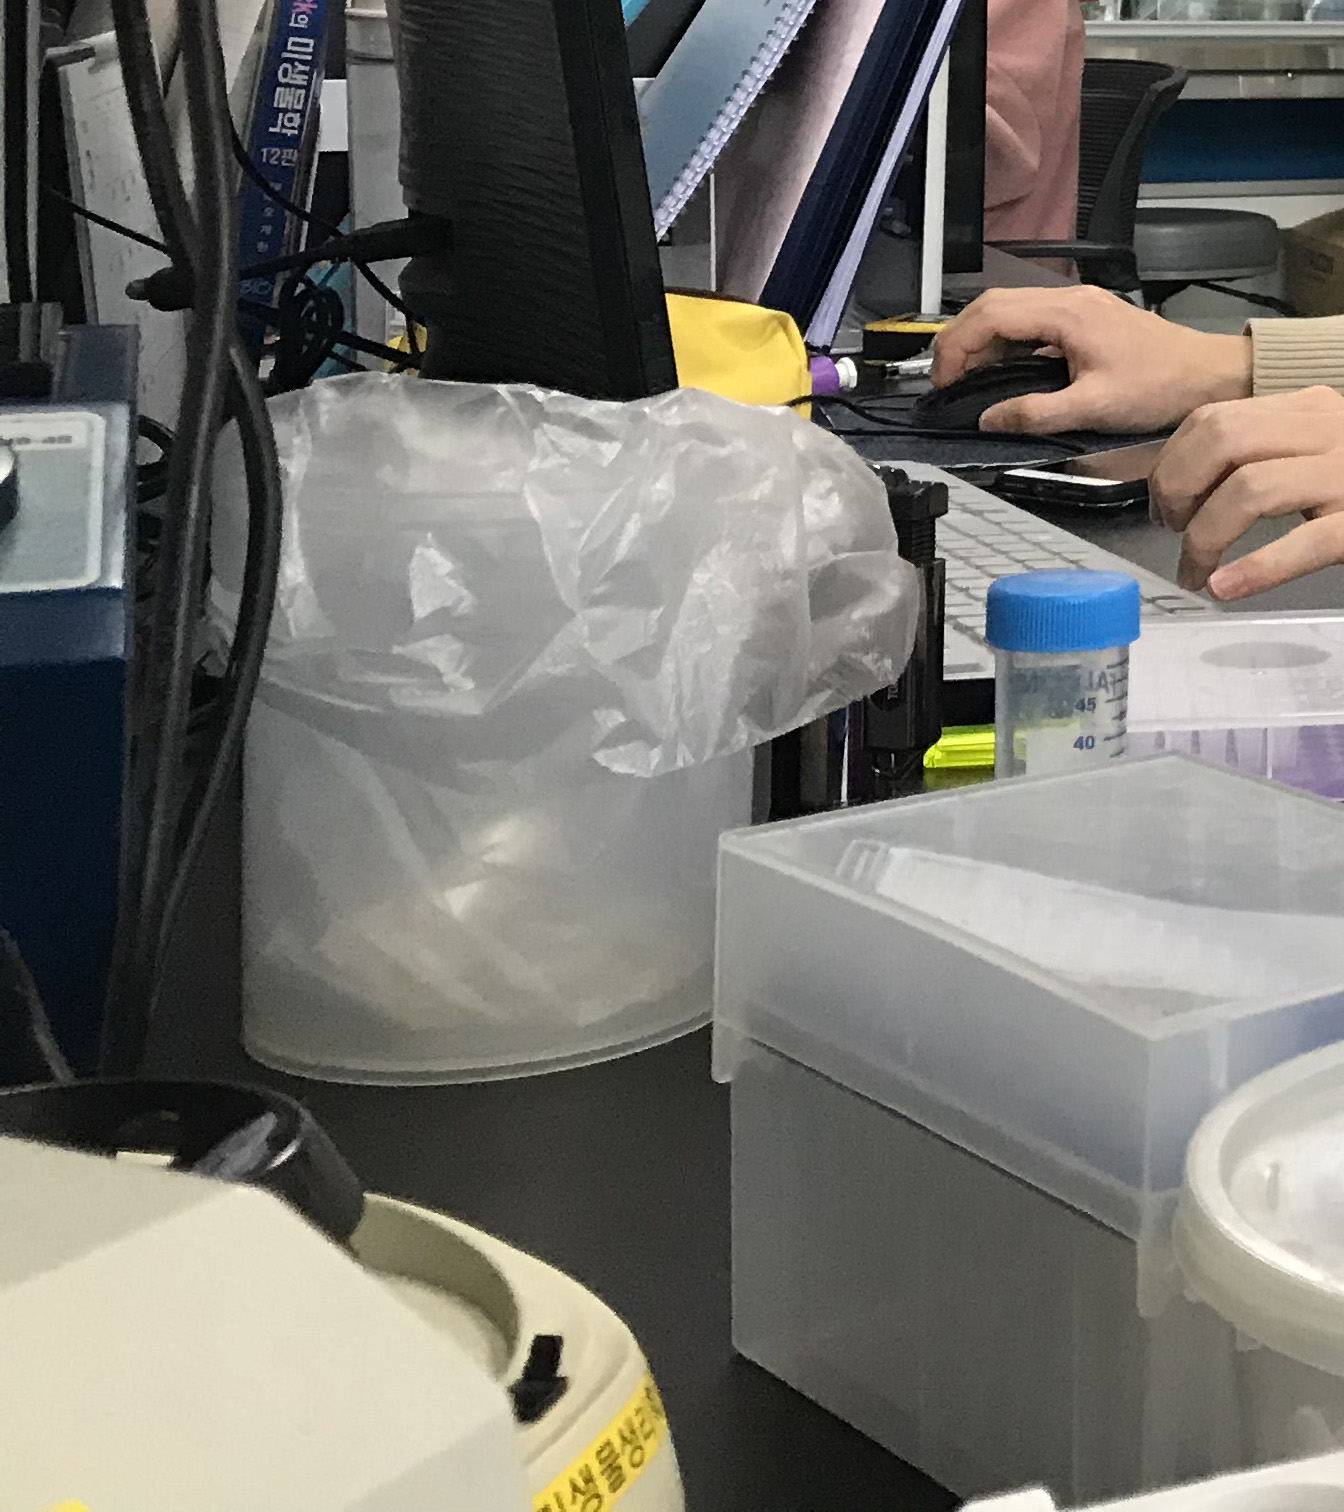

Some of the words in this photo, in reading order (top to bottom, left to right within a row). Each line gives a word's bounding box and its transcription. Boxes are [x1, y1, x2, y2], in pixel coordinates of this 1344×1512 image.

[268, 36, 315, 138] 미생물학
[261, 148, 299, 168] 12판
[1076, 697, 1097, 713] 45
[1073, 735, 1095, 751] 40
